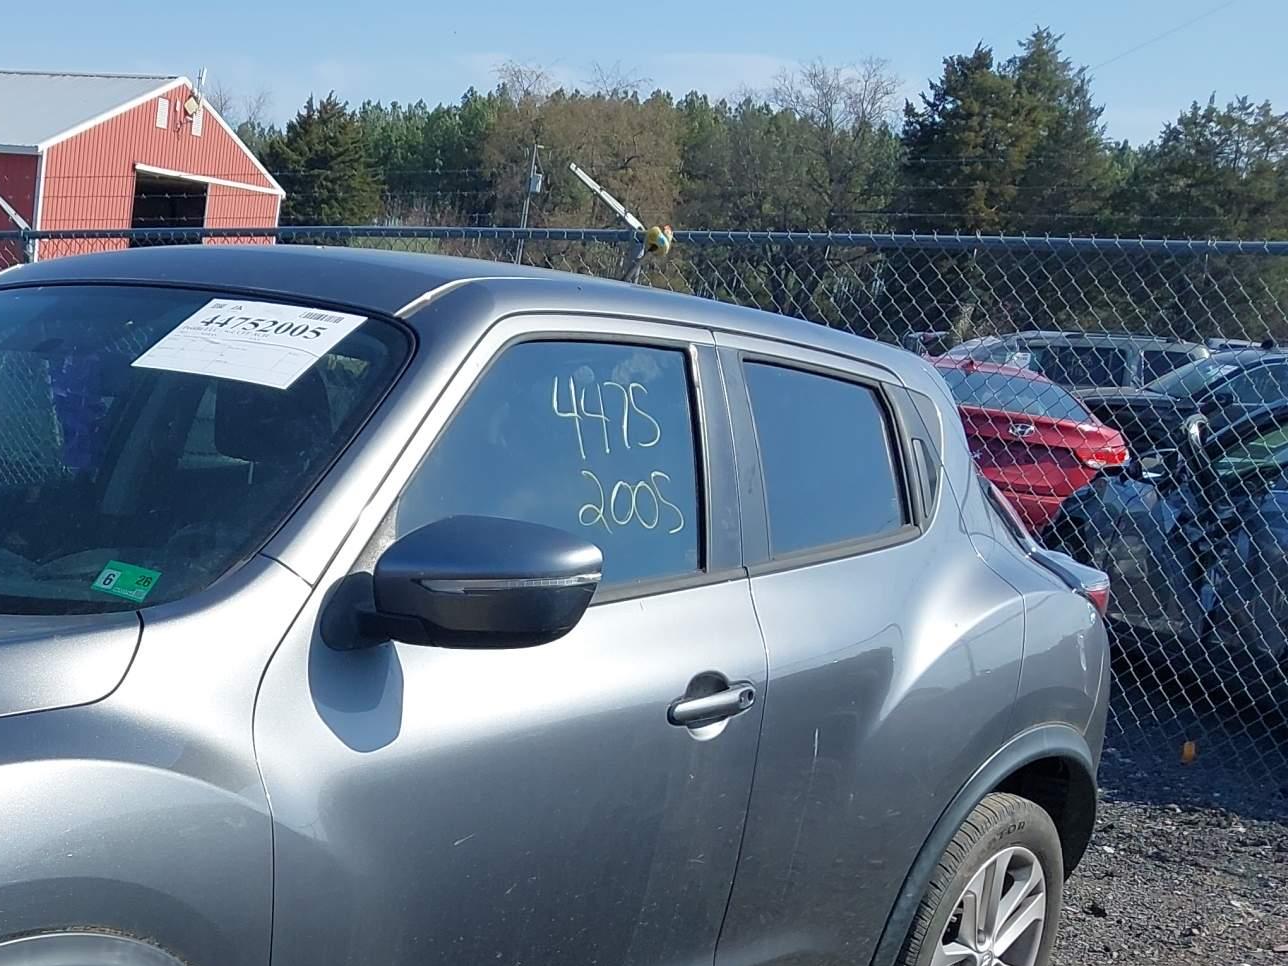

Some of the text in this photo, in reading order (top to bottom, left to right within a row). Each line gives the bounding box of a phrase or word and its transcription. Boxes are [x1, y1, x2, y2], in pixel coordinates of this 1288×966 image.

[200, 314, 329, 340] 44752005
[553, 375, 660, 460] 4475
[578, 470, 685, 534] 2005
[102, 573, 116, 586] 6
[135, 575, 153, 587] 26
